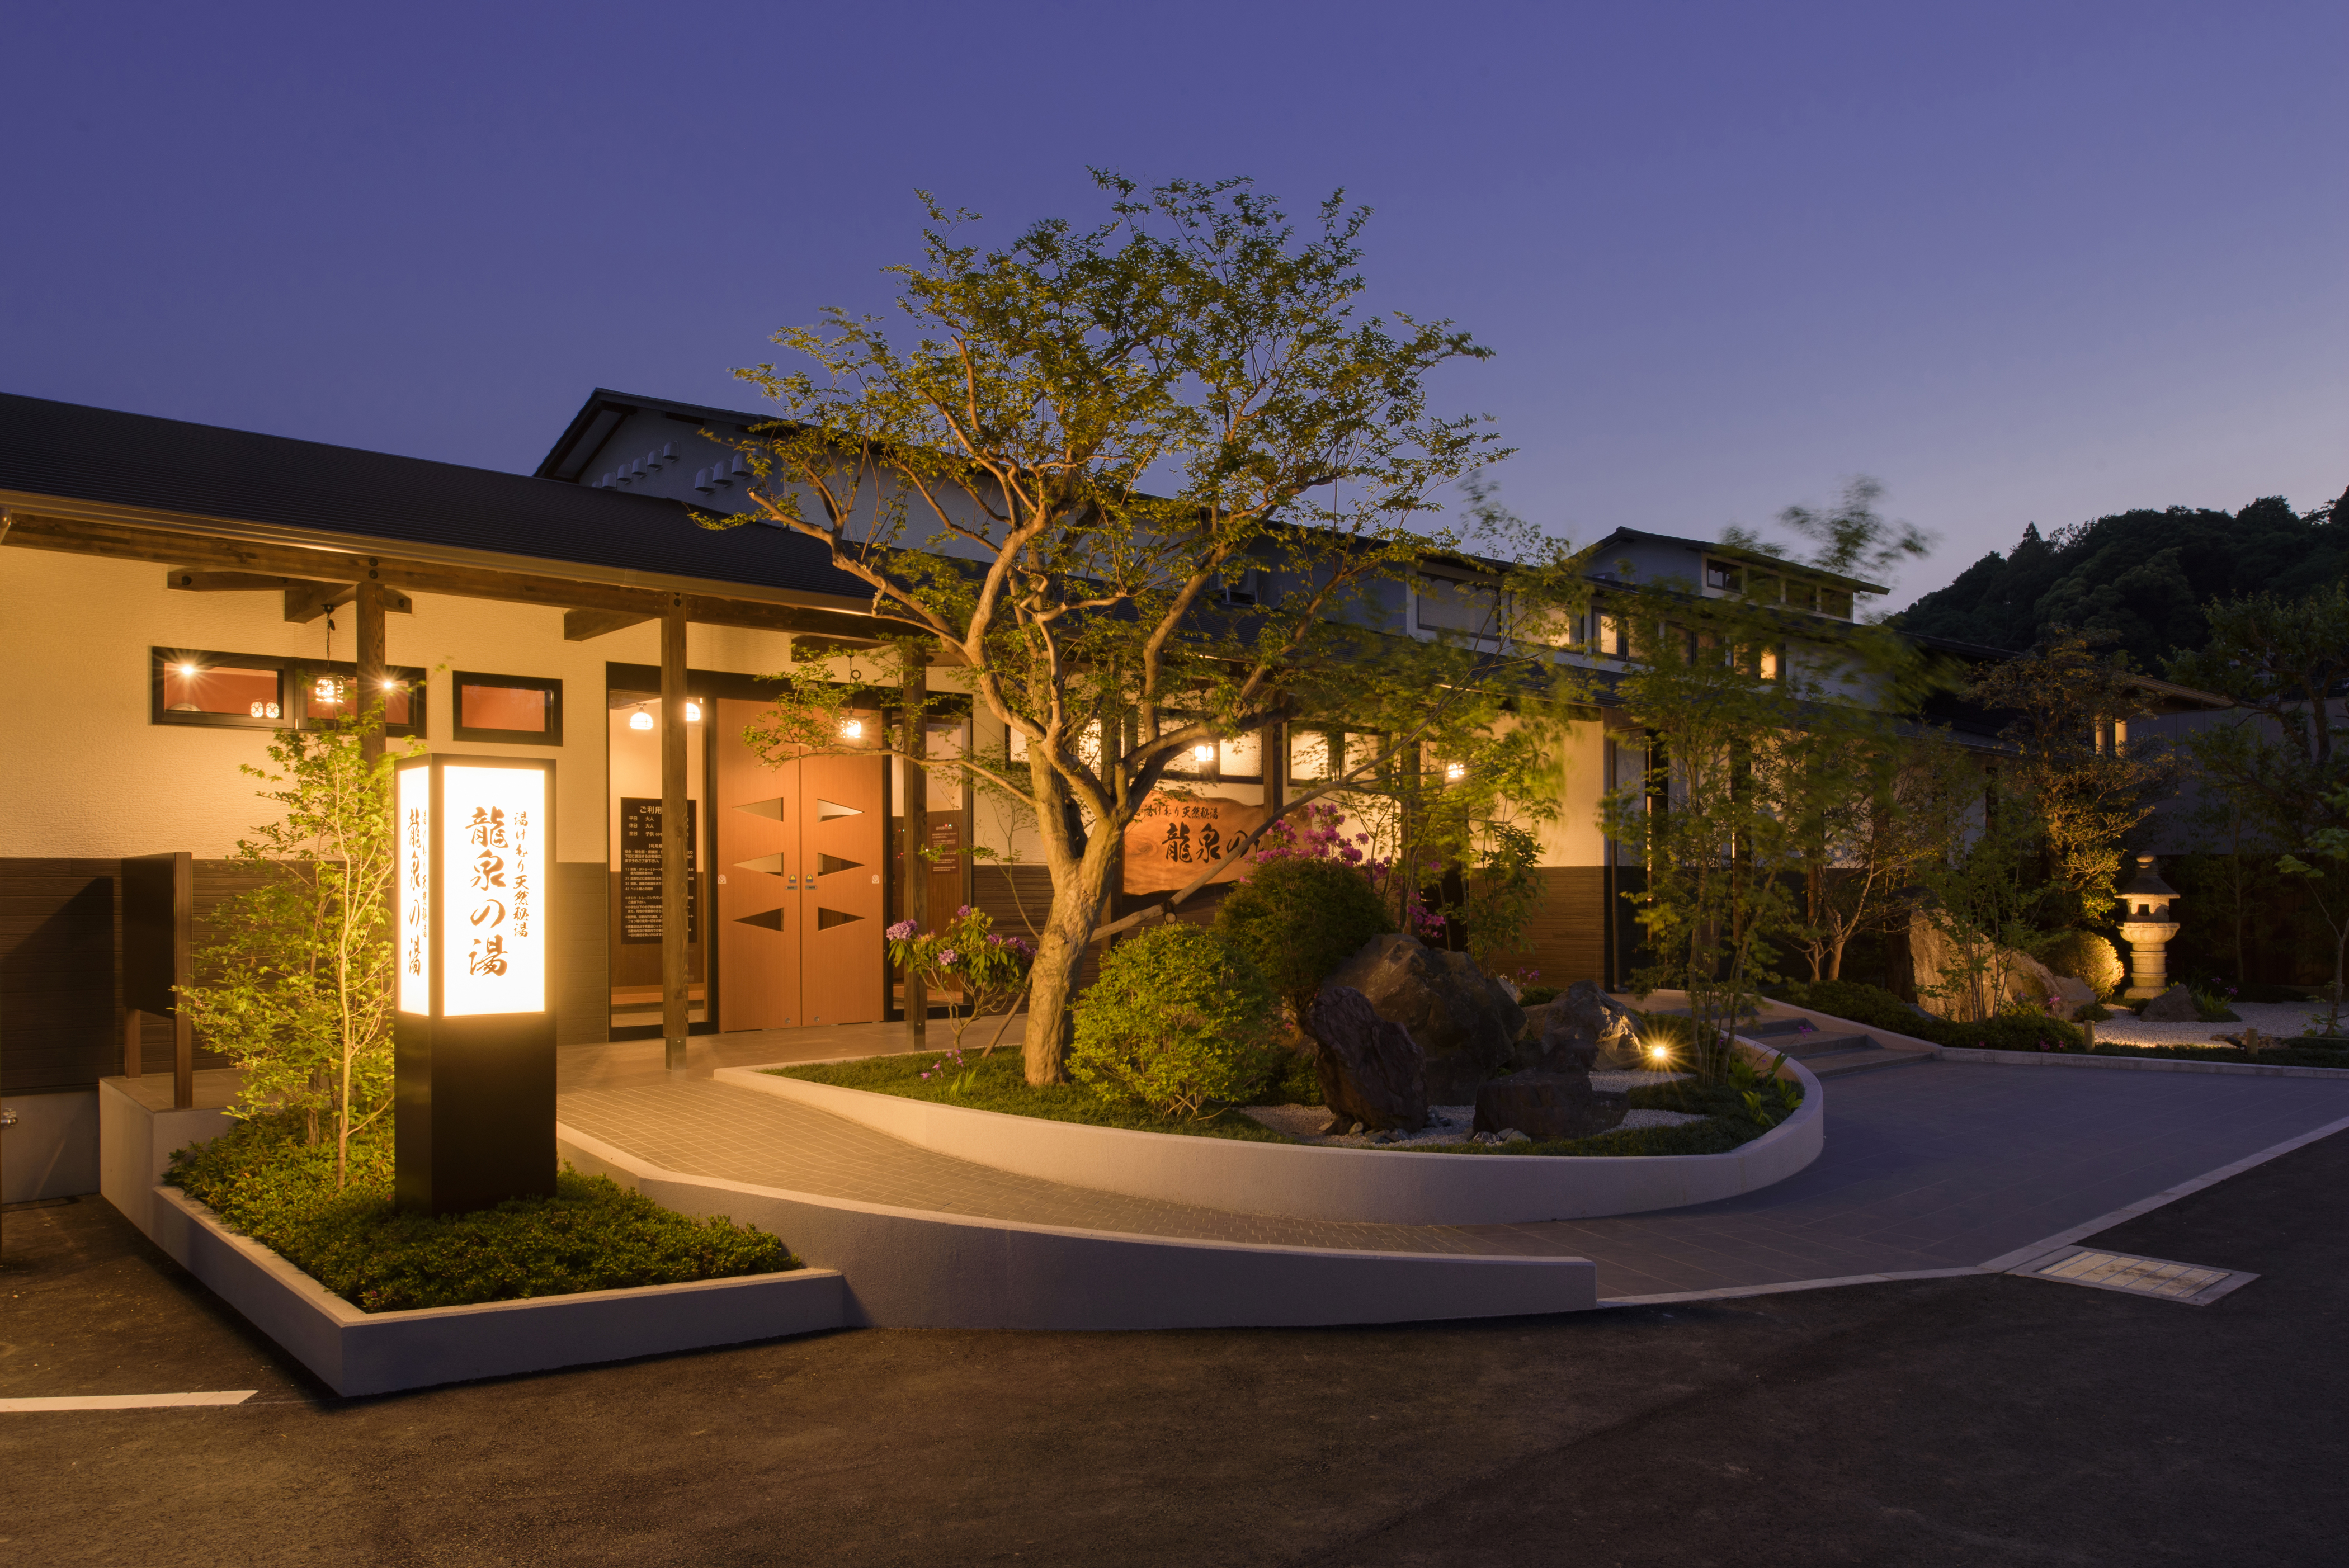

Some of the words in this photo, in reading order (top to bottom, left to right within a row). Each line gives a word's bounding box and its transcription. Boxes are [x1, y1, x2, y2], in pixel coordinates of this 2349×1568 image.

[407, 806, 421, 976] 龍泉の湯
[465, 806, 508, 976] 龍泉の湯
[513, 811, 529, 937] 湯けむり天然秘湯
[1162, 821, 1264, 863] 龍泉の
